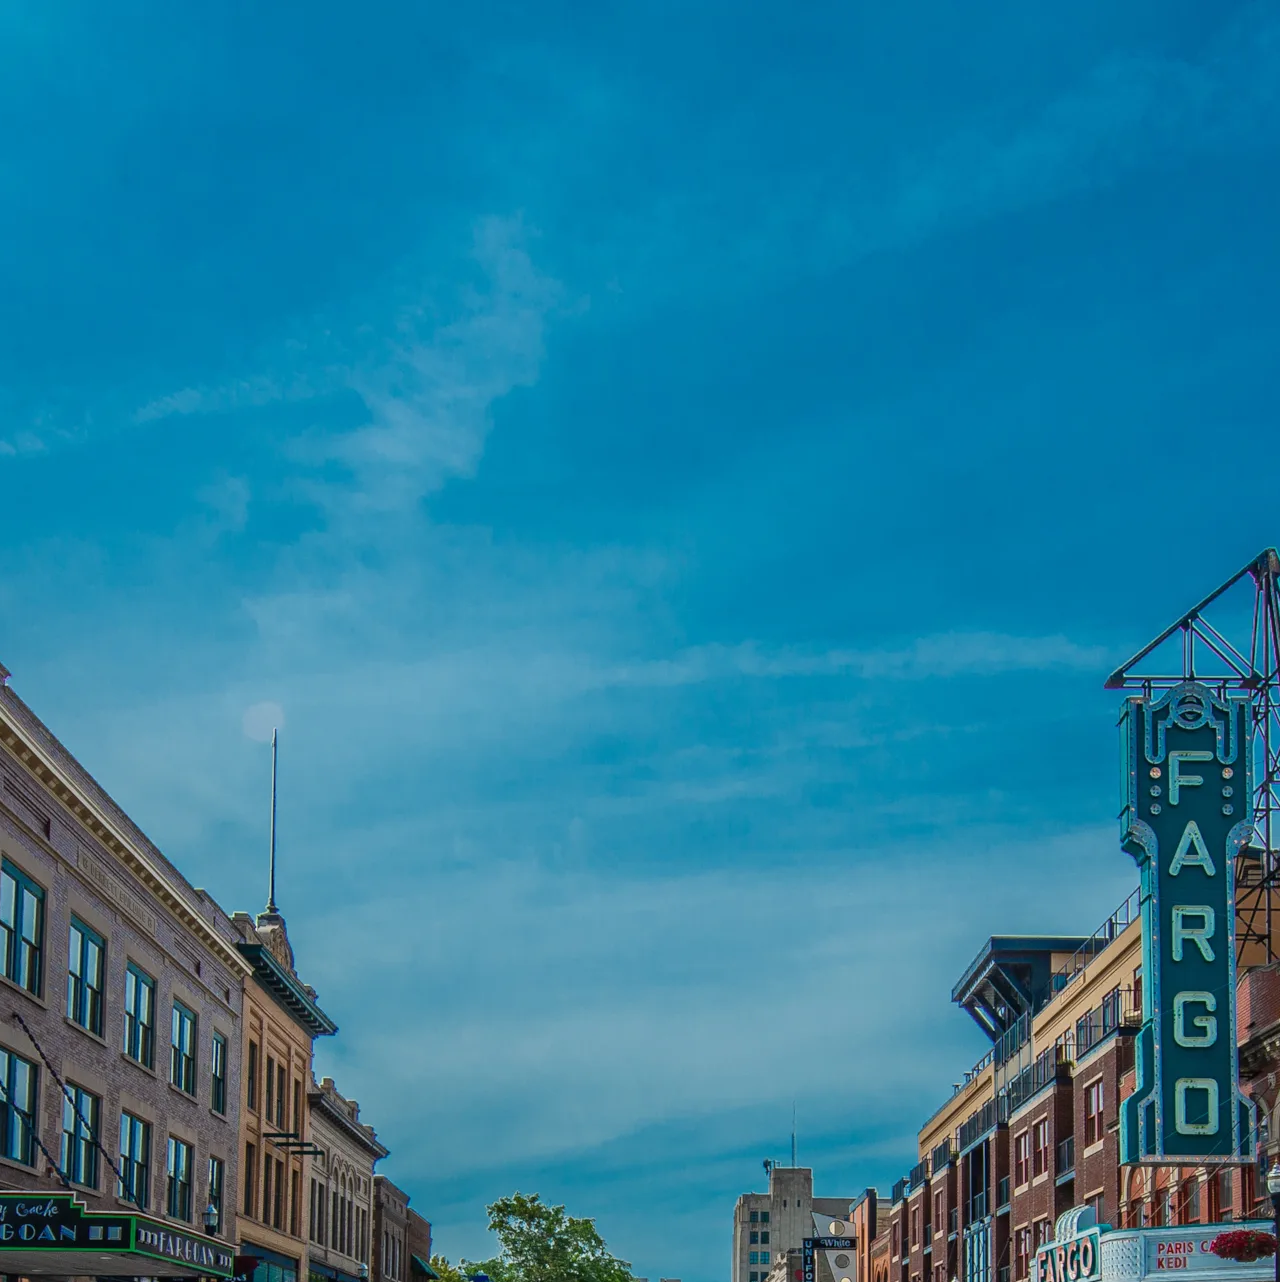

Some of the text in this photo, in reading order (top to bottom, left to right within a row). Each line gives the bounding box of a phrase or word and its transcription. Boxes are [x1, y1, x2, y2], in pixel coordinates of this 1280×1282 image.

[1168, 749, 1220, 1136] FARGO
[159, 1231, 214, 1266] FARGOAN
[820, 1238, 851, 1248] White
[1157, 1241, 1194, 1255] PARIS
[1156, 1256, 1187, 1269] KEDI
